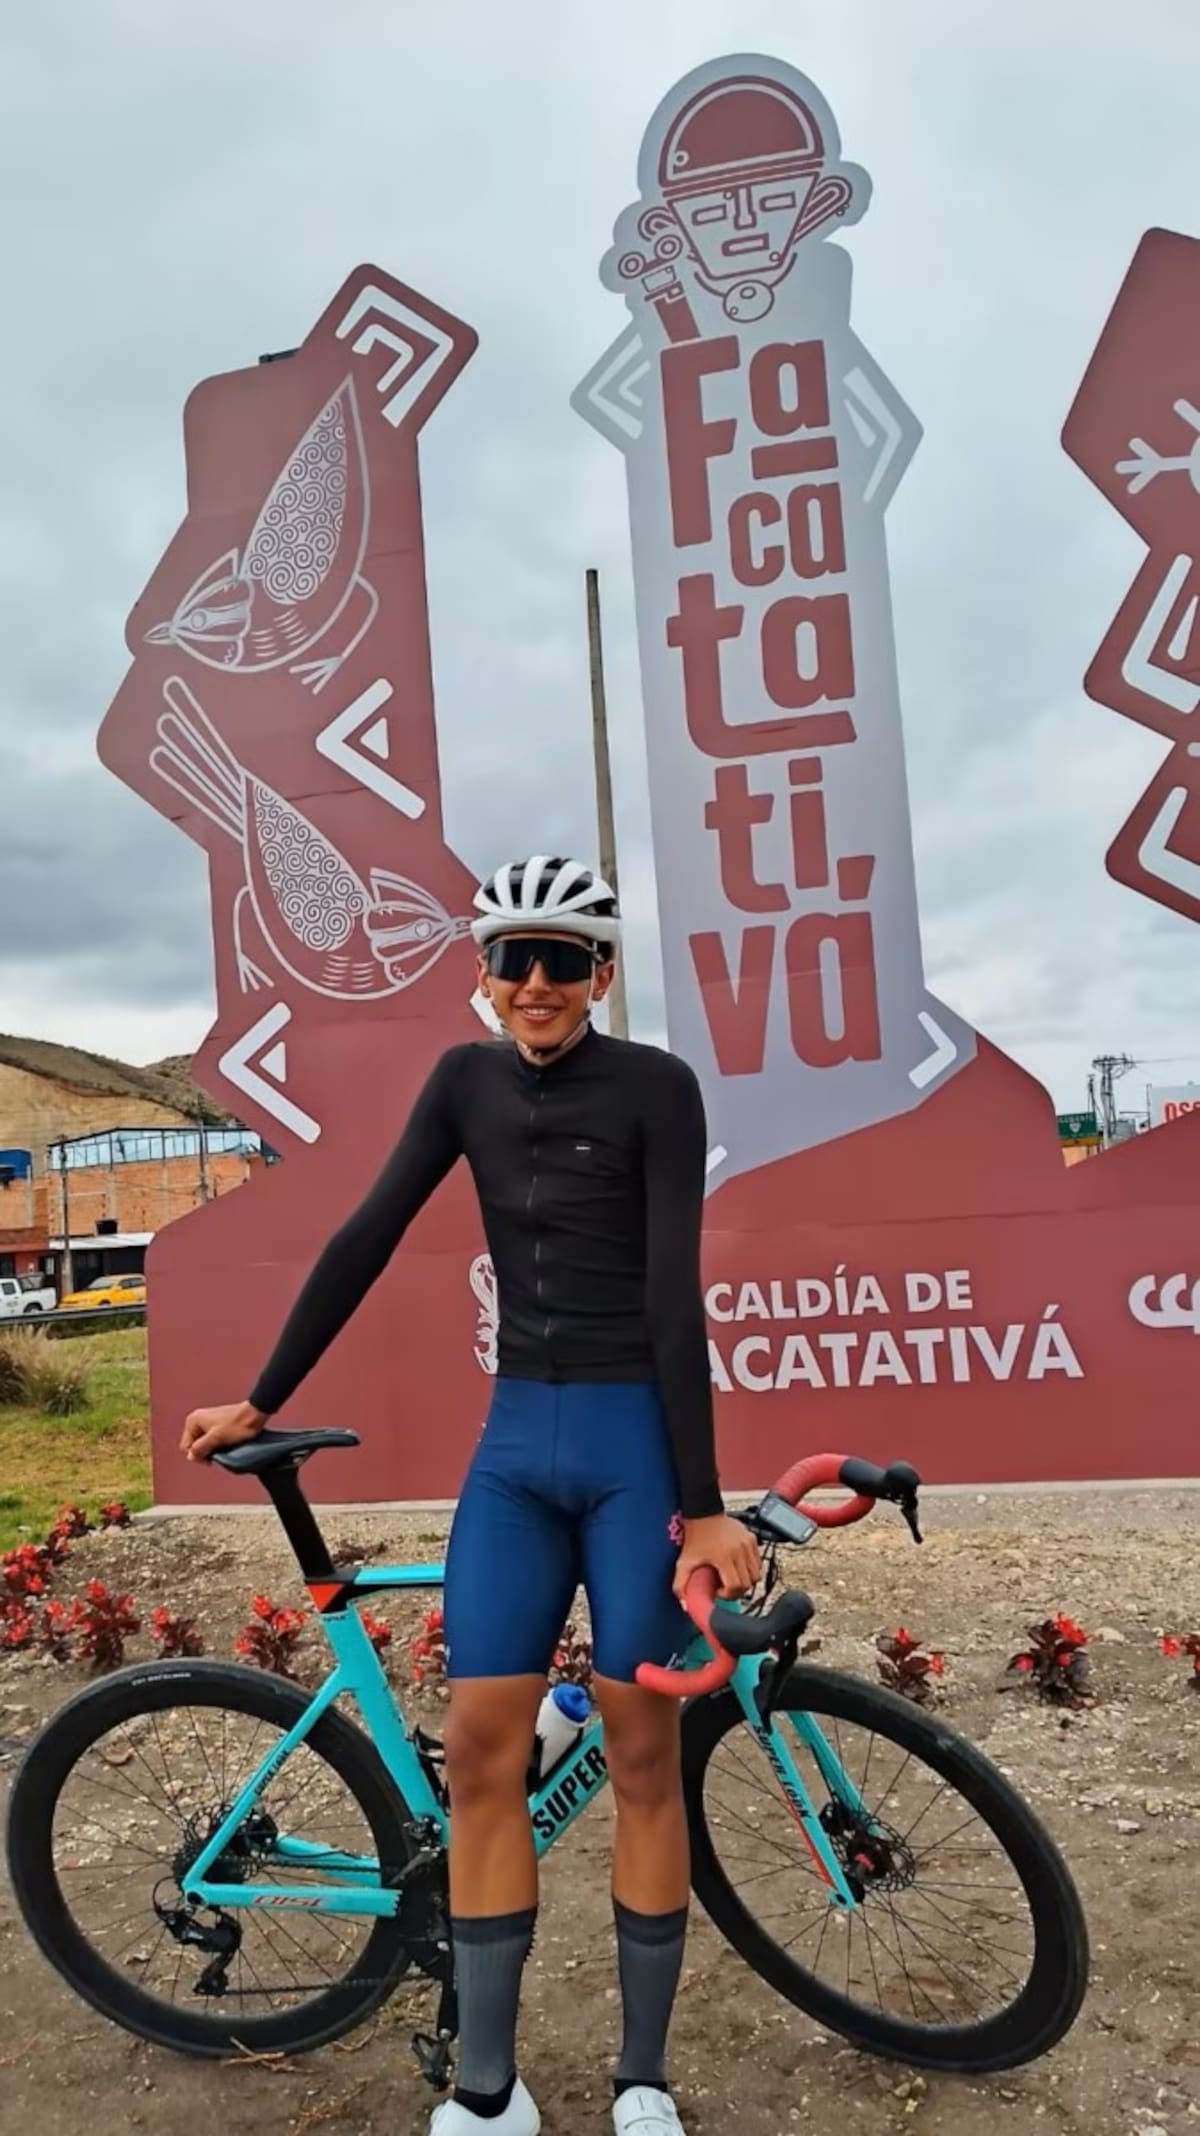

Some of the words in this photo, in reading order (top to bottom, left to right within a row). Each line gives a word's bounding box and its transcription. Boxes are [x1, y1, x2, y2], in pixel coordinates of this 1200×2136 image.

[704, 1264, 890, 1323] CALDÍA
[905, 1269, 973, 1314] DE
[532, 1745, 608, 1840] SUPER
